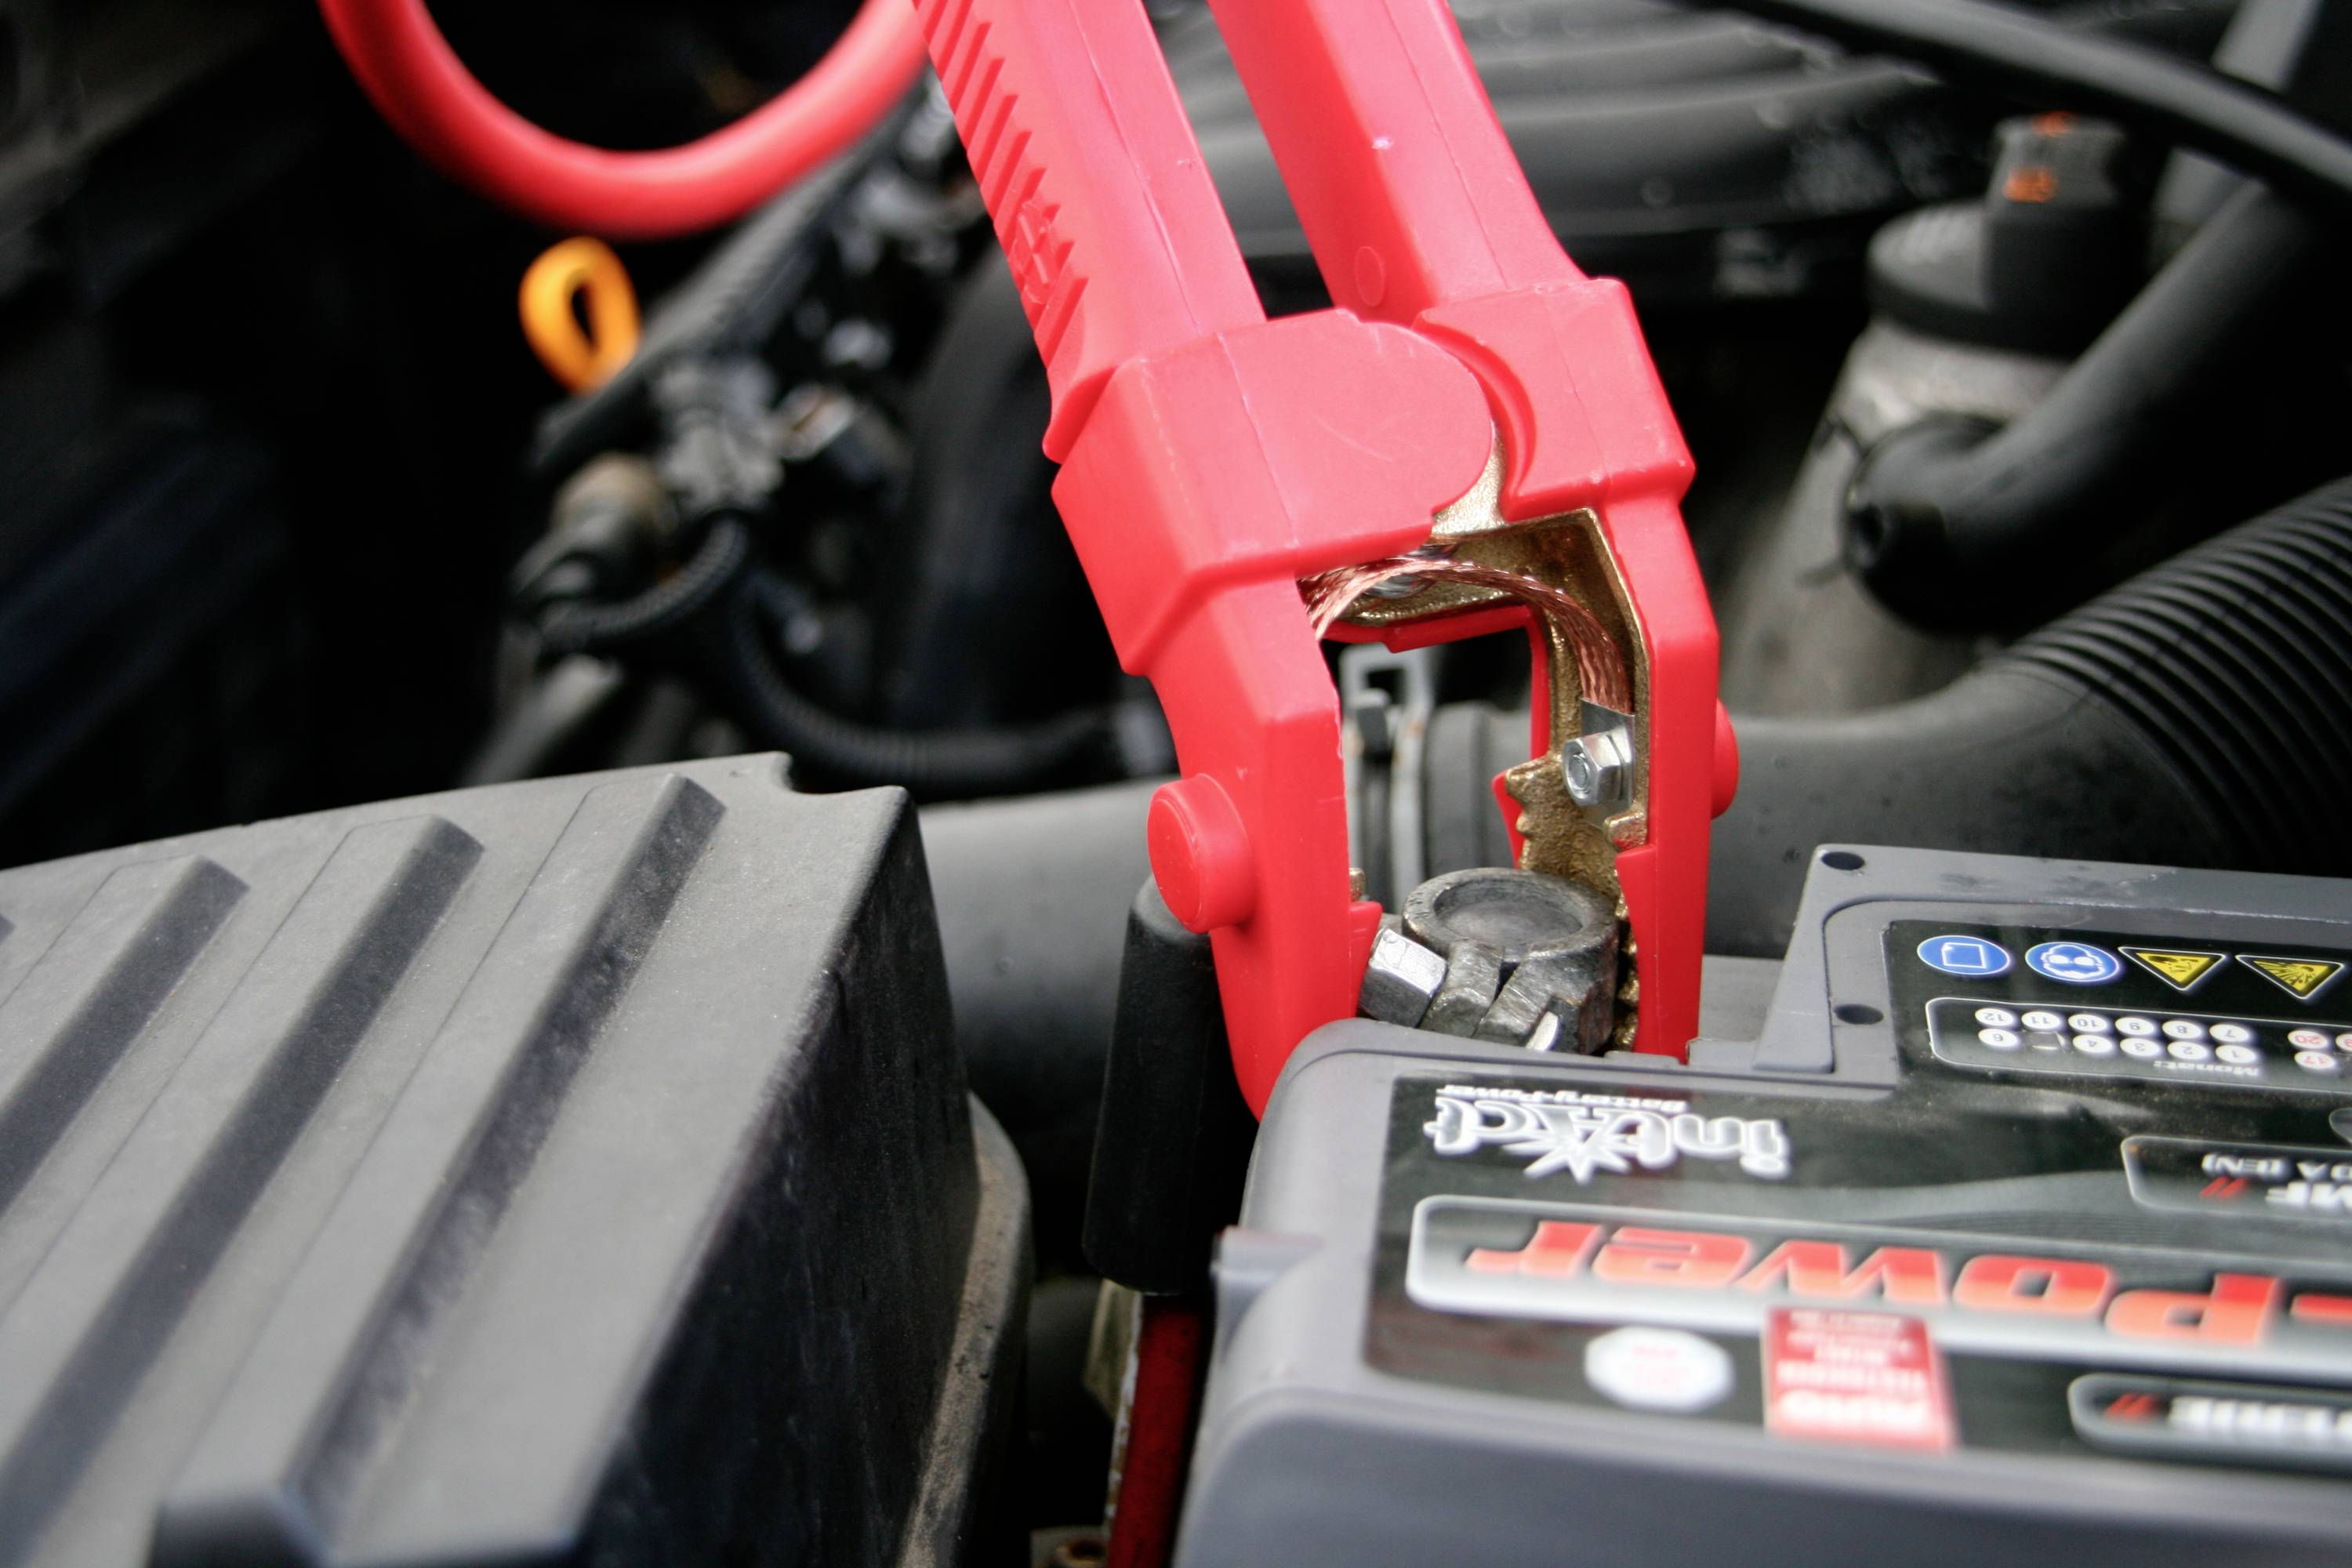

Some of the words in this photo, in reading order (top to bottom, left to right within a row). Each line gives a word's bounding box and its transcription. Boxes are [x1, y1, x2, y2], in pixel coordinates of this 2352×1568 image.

[1984, 1012, 2005, 1022] 12
[2029, 1015, 2052, 1025] 11
[2076, 1018, 2099, 1029] 10
[2294, 1034, 2321, 1045] 20
